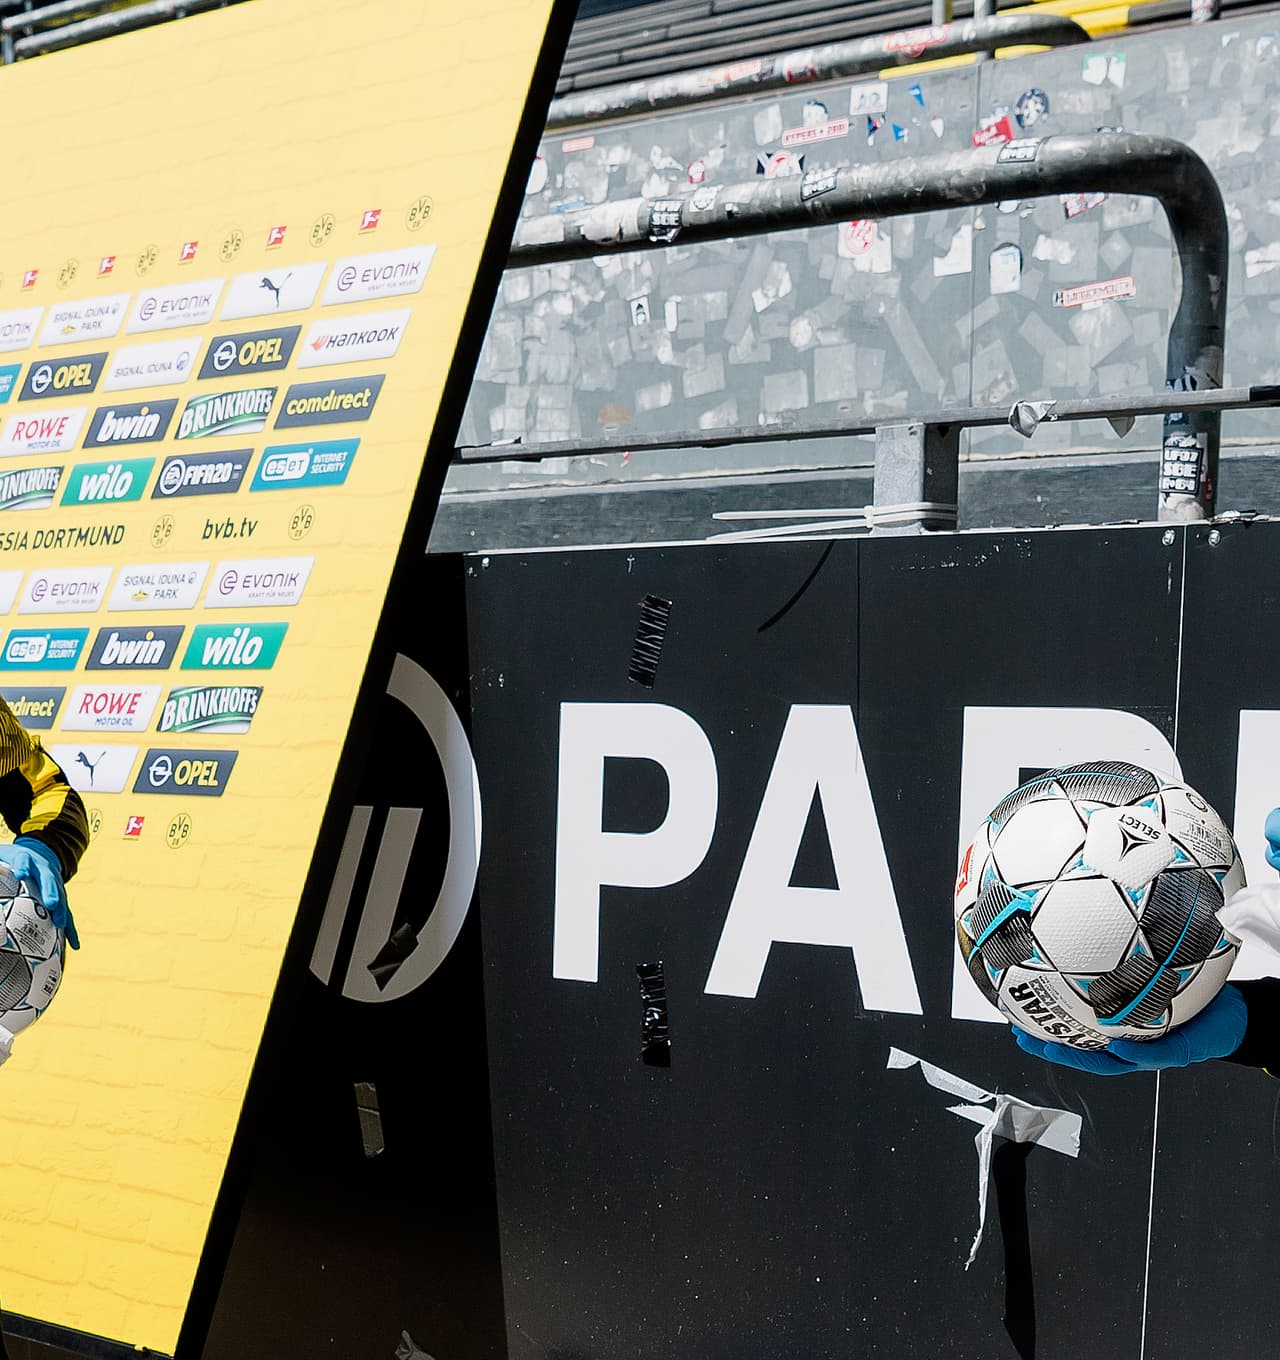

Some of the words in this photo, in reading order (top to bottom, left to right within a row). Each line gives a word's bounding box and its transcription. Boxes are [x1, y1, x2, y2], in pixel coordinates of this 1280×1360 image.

[361, 261, 422, 284] EVONIK
[161, 293, 213, 314] EVONIK
[81, 320, 105, 334] PARK
[238, 337, 284, 367] OPEL
[53, 363, 92, 390] OPEL
[286, 387, 371, 416] comdirect
[12, 416, 70, 441] ROWE
[97, 407, 161, 442] bwin
[78, 464, 134, 501] wilo
[32, 524, 126, 550] DORTMUND
[202, 518, 258, 541] bvb.tv
[51, 581, 100, 597] EVONIK
[124, 576, 156, 587] SIGNAL
[157, 573, 186, 585] IDUNA
[242, 572, 300, 590] EVONIK
[154, 589, 179, 600] PARK
[100, 631, 166, 665] bwin
[202, 627, 264, 666] wilo
[79, 692, 142, 716] ROWE
[174, 759, 219, 787] OPEL
[1117, 812, 1162, 842] SELECT
